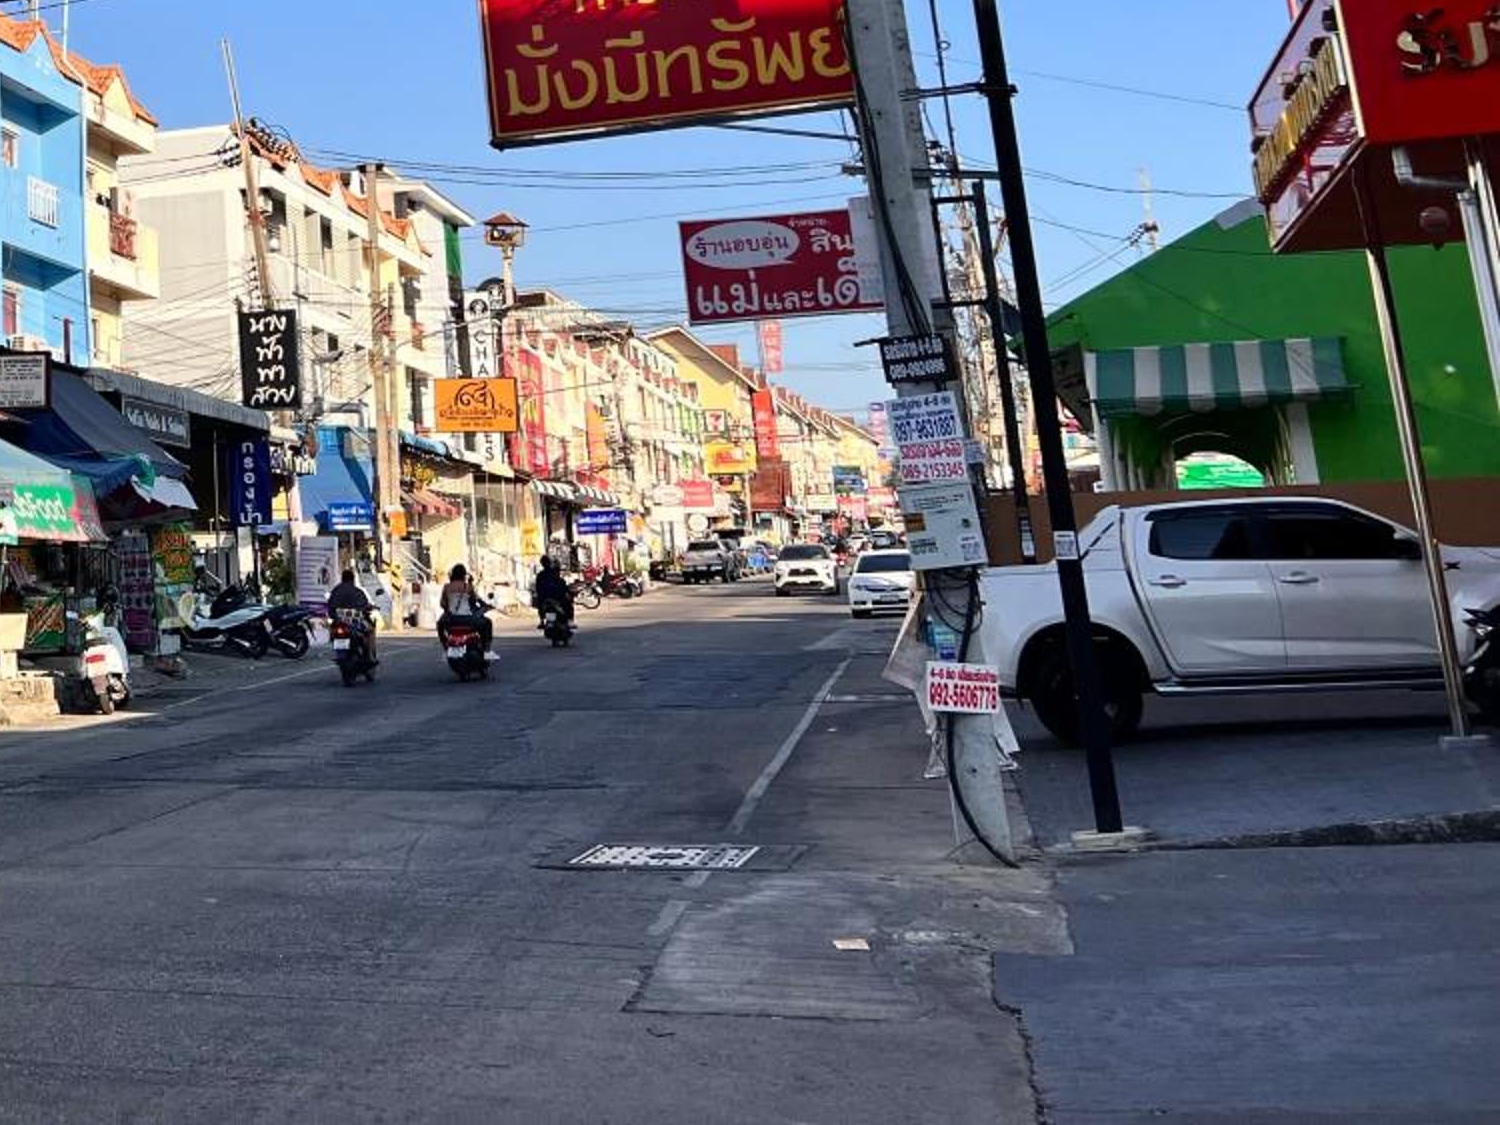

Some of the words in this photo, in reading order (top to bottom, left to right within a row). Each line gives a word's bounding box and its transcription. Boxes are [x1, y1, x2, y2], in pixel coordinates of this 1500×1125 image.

[695, 231, 789, 258] ร้านอบอุ่น
[697, 257, 860, 315] แม่และเด็
[249, 314, 287, 332] นาง
[256, 334, 283, 362] ฟ้า
[250, 385, 295, 406] สวย
